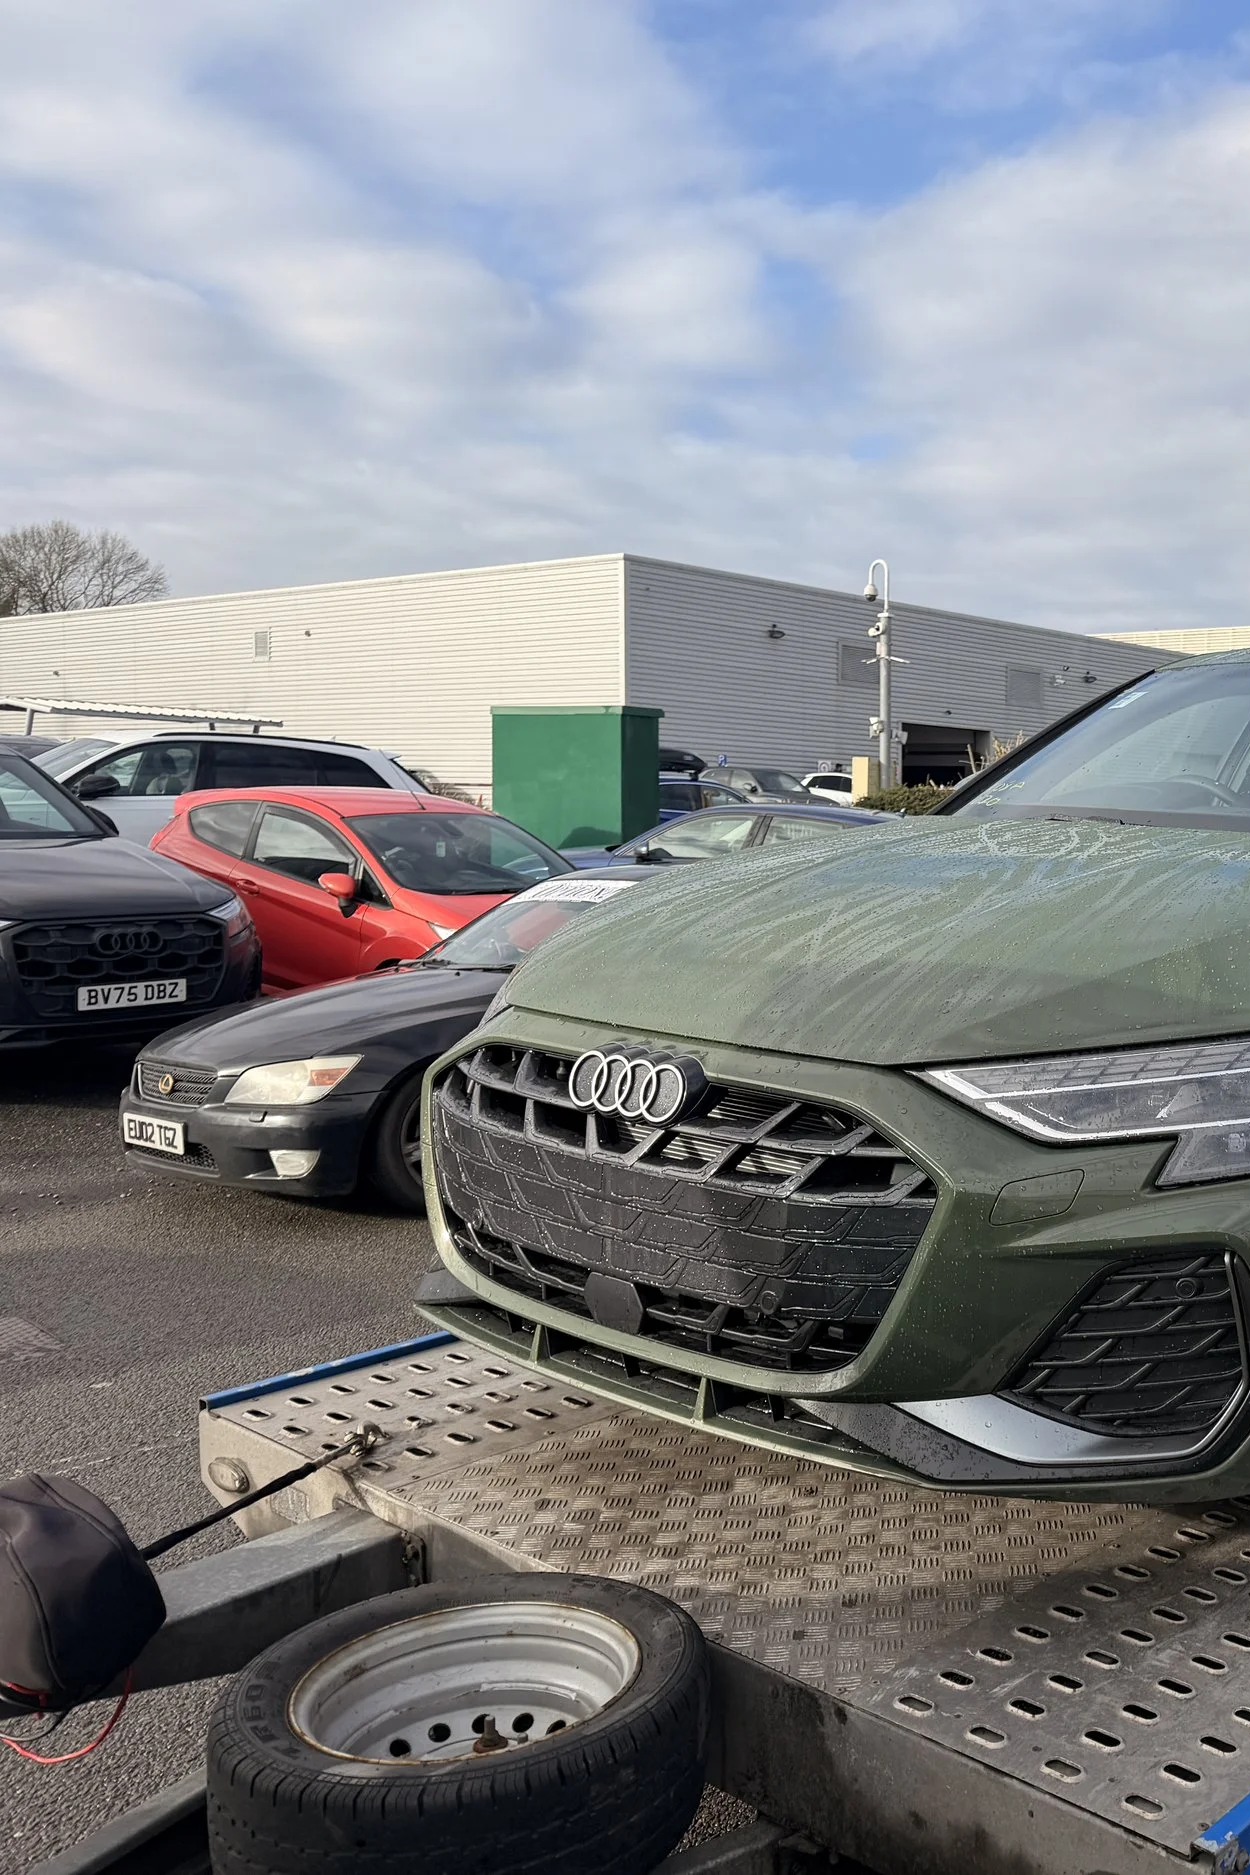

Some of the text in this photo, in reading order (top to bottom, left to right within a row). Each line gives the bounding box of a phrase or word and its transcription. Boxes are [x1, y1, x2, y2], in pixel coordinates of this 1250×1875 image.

[86, 982, 179, 1006] BV75 DBZ
[127, 1118, 178, 1149] EU02 TGZ
